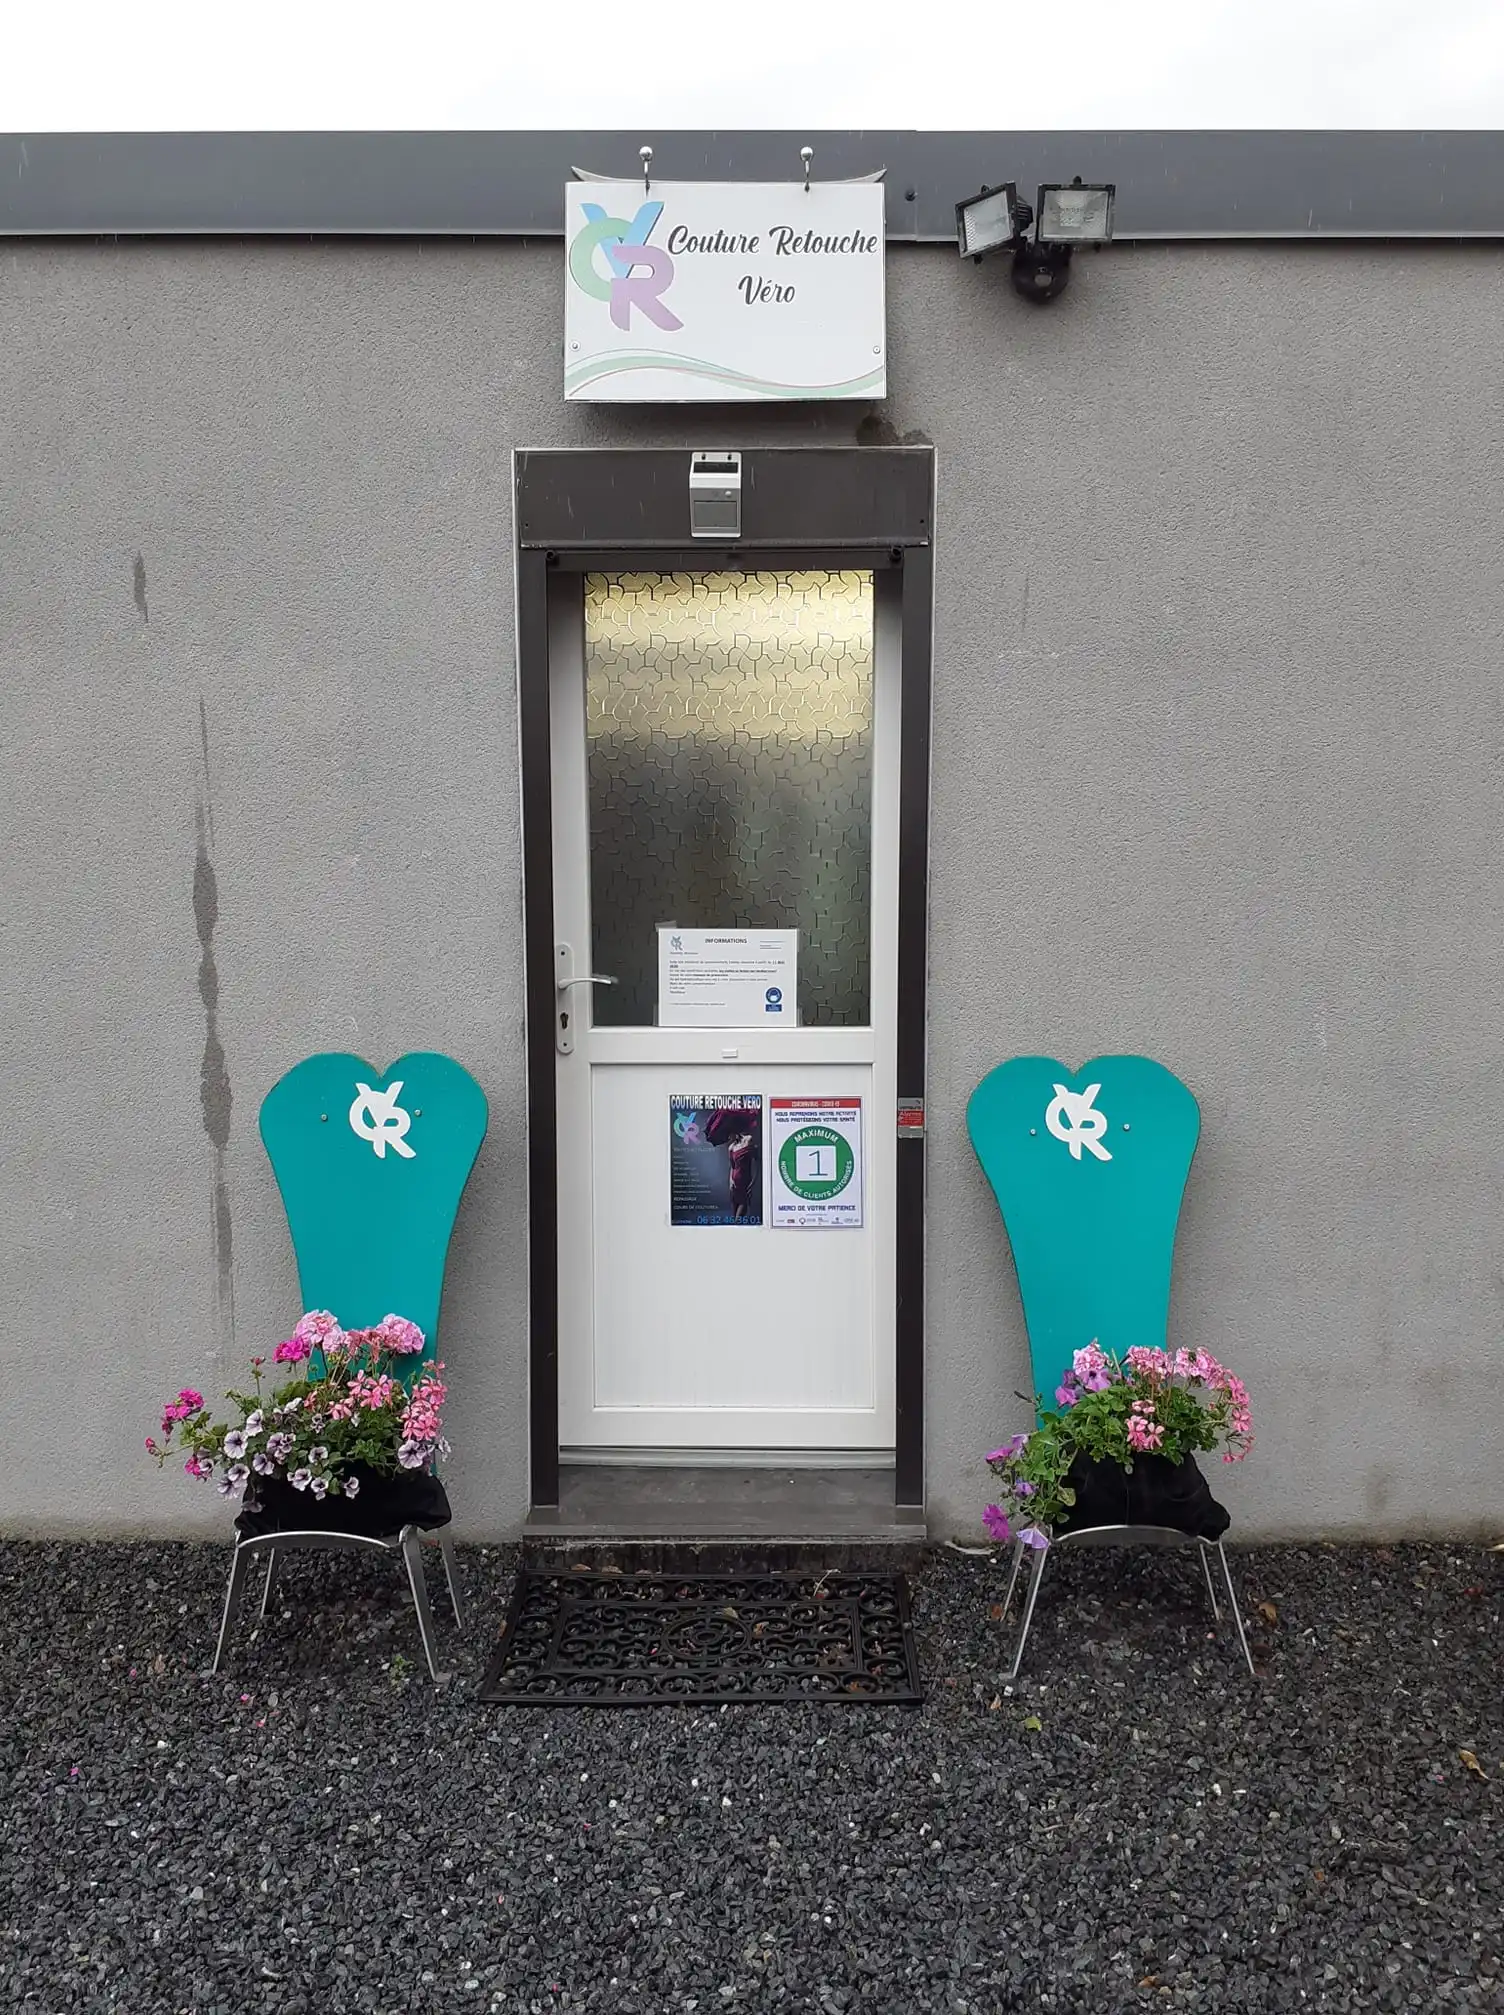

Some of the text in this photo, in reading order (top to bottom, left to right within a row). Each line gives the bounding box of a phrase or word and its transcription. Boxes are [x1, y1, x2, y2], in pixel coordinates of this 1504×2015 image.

[667, 225, 878, 256] Couture Retouche
[738, 275, 796, 305] Véro
[671, 1096, 703, 1109] COUTURE
[704, 1096, 741, 1109] RETOUCHE
[794, 1128, 839, 1143] MAXIMUM
[808, 1150, 828, 1176] 1
[803, 1190, 832, 1199] CLIENTS
